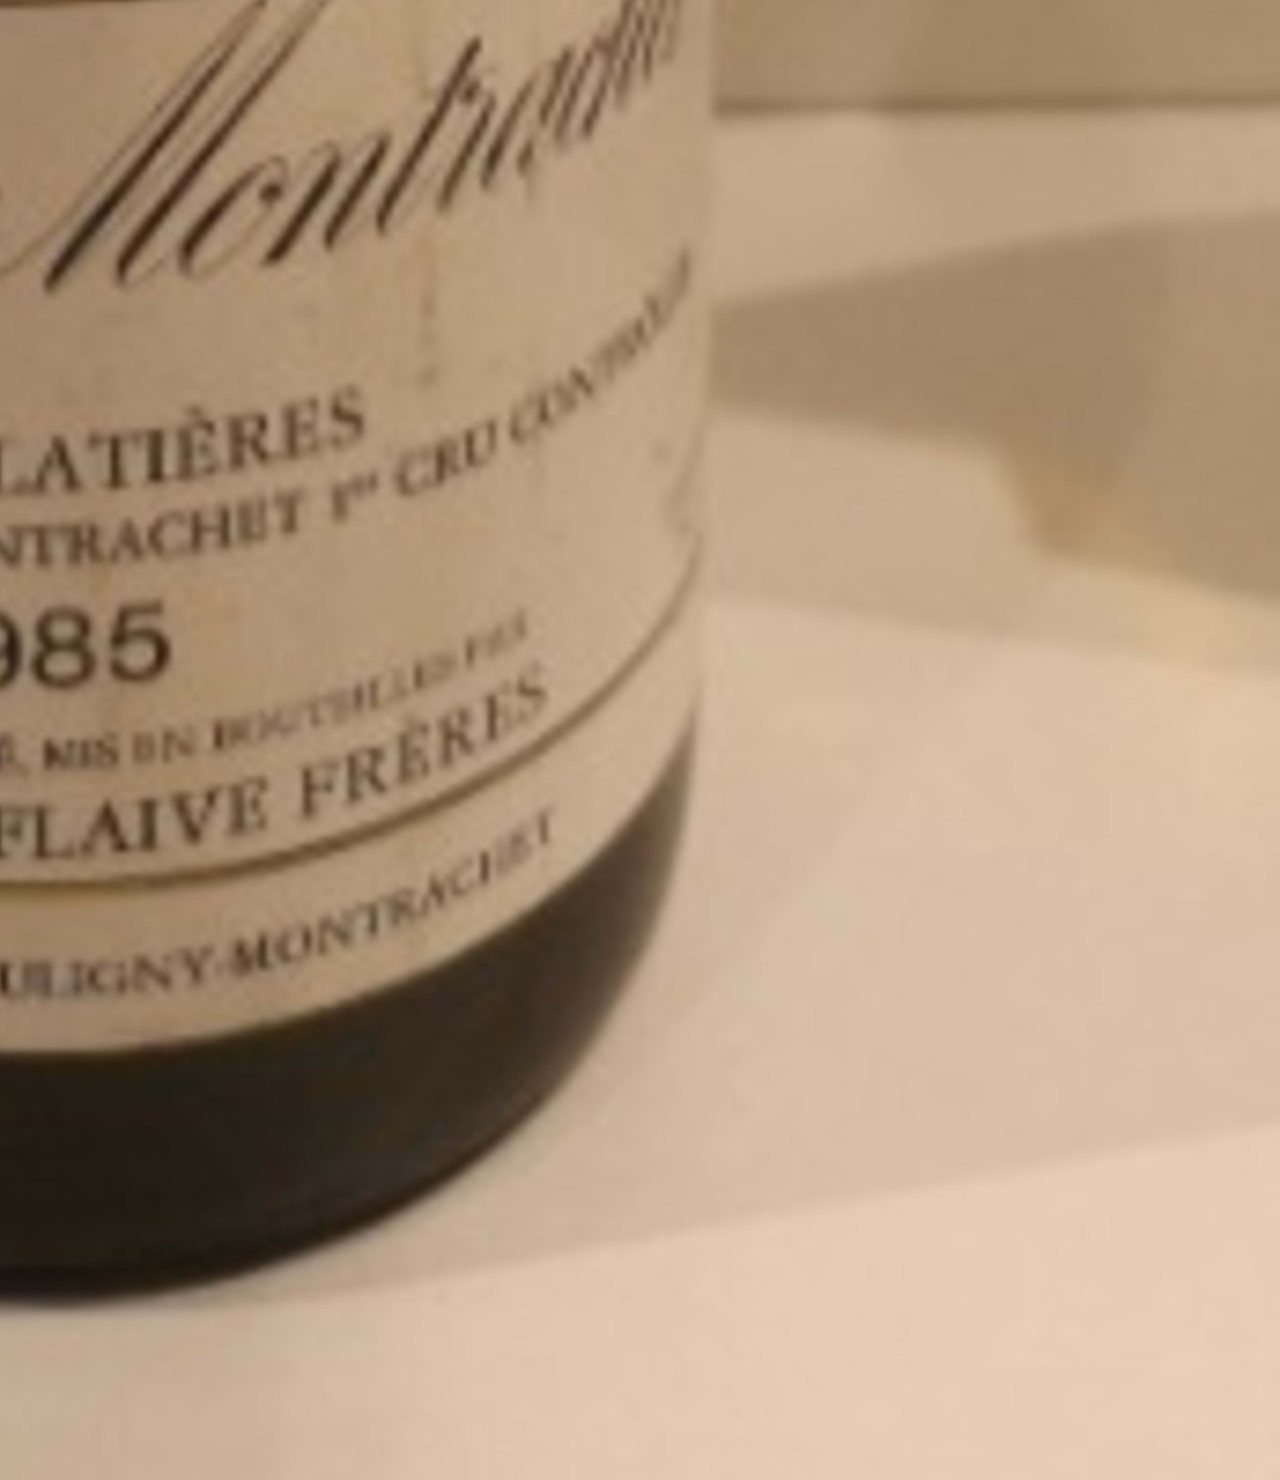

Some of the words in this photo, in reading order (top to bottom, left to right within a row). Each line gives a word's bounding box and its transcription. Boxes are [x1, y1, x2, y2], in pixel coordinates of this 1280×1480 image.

[393, 413, 504, 503] CRU
[41, 735, 120, 773] MIS
[131, 725, 199, 769] EN
[298, 659, 552, 823] FRÈRES
